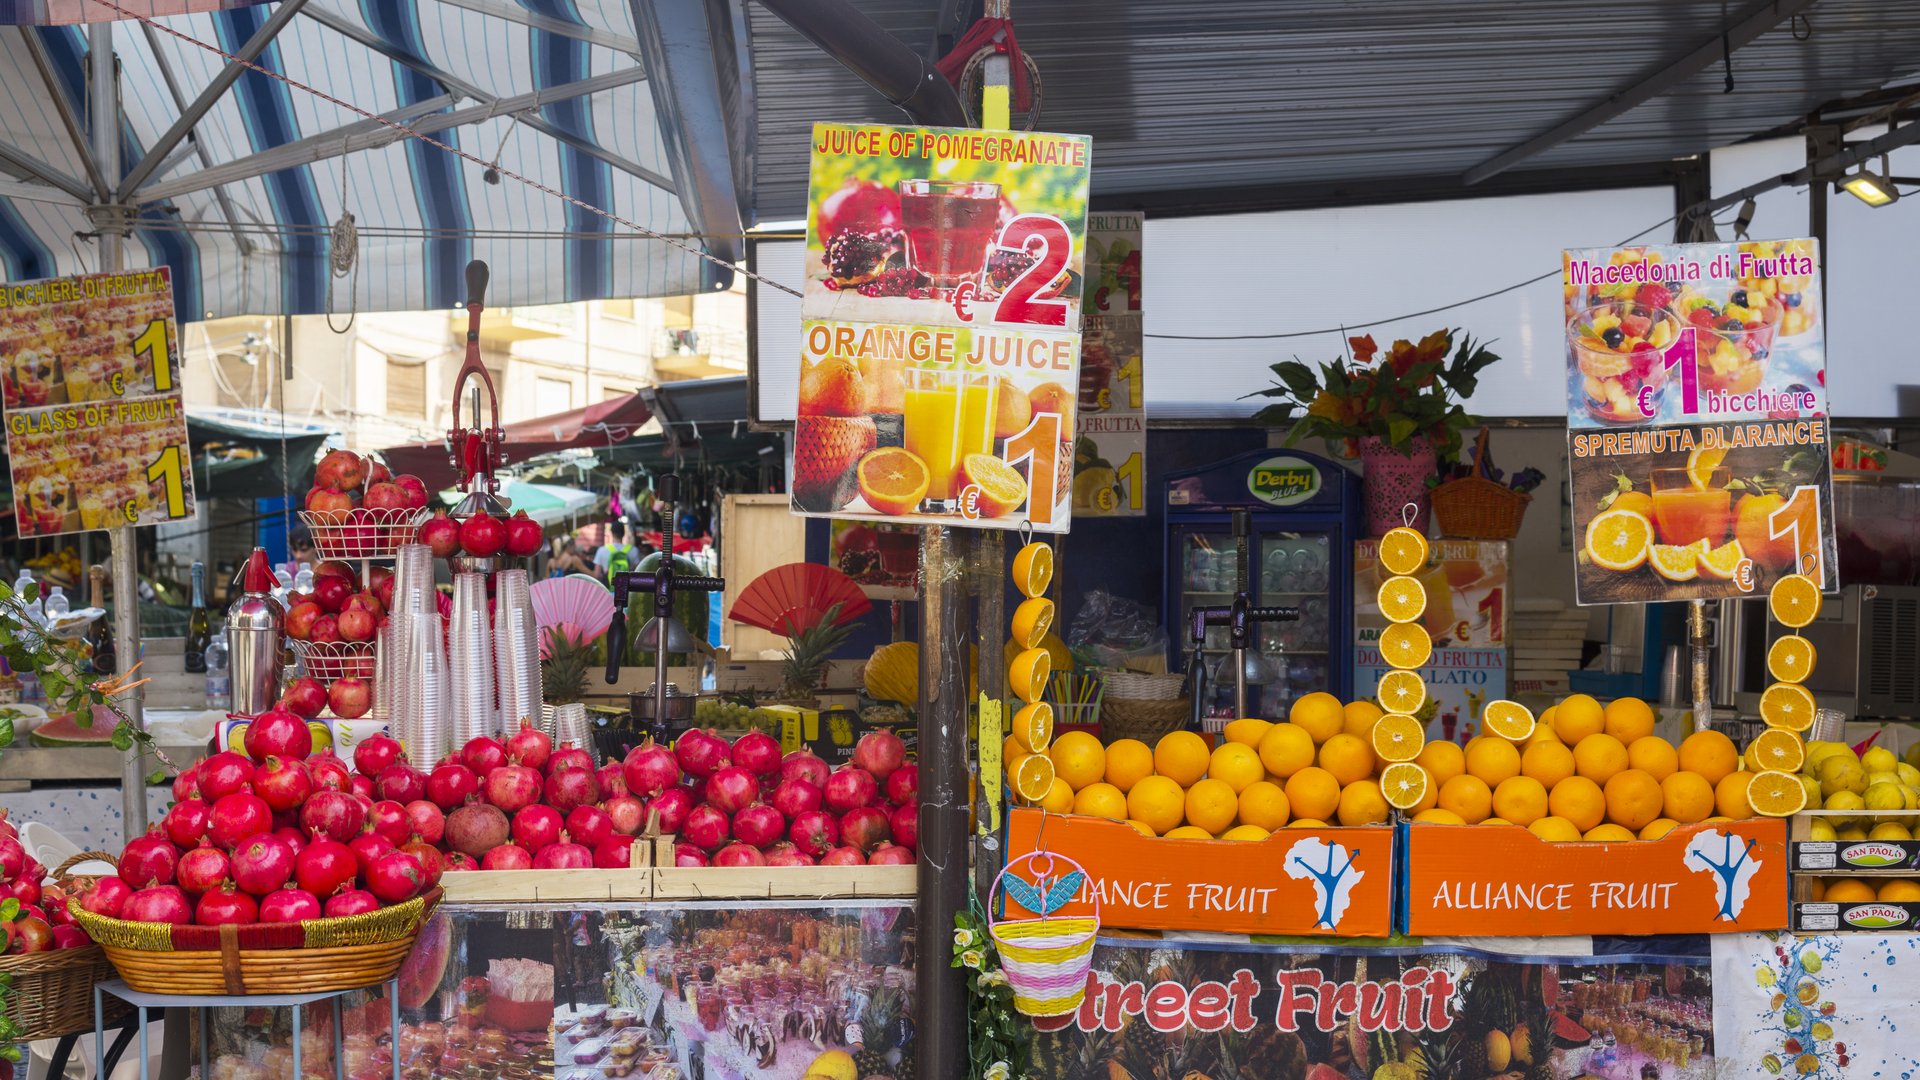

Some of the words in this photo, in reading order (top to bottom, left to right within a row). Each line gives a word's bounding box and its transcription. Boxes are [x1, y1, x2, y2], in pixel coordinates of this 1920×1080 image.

[818, 130, 881, 156] JUICE
[888, 131, 917, 158] OF
[922, 134, 1085, 167] POMEGRANATE
[953, 281, 976, 323] €
[994, 213, 1073, 327] 2
[1117, 250, 1141, 310] 1
[1570, 256, 1700, 286] Macedonia
[1709, 255, 1731, 279] di
[1739, 251, 1813, 278] Frutta
[0, 281, 81, 308] BICCHIERE
[85, 279, 101, 299] DI
[106, 272, 166, 297] FRUTTA
[111, 373, 124, 395] €
[133, 318, 173, 392] 1
[809, 325, 954, 363] ORANGE
[966, 334, 1071, 370] JUICE
[1117, 353, 1143, 408] 1
[1637, 385, 1655, 417] €
[1663, 326, 1700, 416] 1
[11, 408, 77, 435] GLASS
[85, 405, 110, 428] OF
[118, 399, 178, 425] FRUIT
[1707, 388, 1816, 415] bicchiere
[1085, 417, 1141, 431] FRUTTA
[1574, 428, 1695, 458] SPREMUTA
[1702, 426, 1724, 451] DI
[1731, 421, 1825, 449] ARANCE
[125, 500, 138, 522] €
[146, 445, 187, 518] 1
[960, 484, 981, 520] €
[1003, 412, 1062, 526] 1
[1118, 452, 1143, 510] 1
[1257, 471, 1310, 490] Derby
[1271, 486, 1298, 499] BLUE
[1734, 558, 1754, 592] €
[1768, 484, 1826, 590] 1
[1455, 621, 1470, 641] €
[1479, 588, 1503, 642] 1
[1443, 652, 1503, 666] FRUTTA
[1847, 848, 1867, 859] SAN
[1869, 848, 1902, 859] PAOLO
[1187, 883, 1278, 914] FRUIT
[1432, 880, 1576, 911] ALLIANCE
[1589, 881, 1679, 910] FRUIT
[1849, 910, 1869, 921] SAN
[1872, 908, 1904, 919] PAOLO
[1031, 968, 1260, 1033] treet
[1276, 967, 1456, 1033] Fruit
